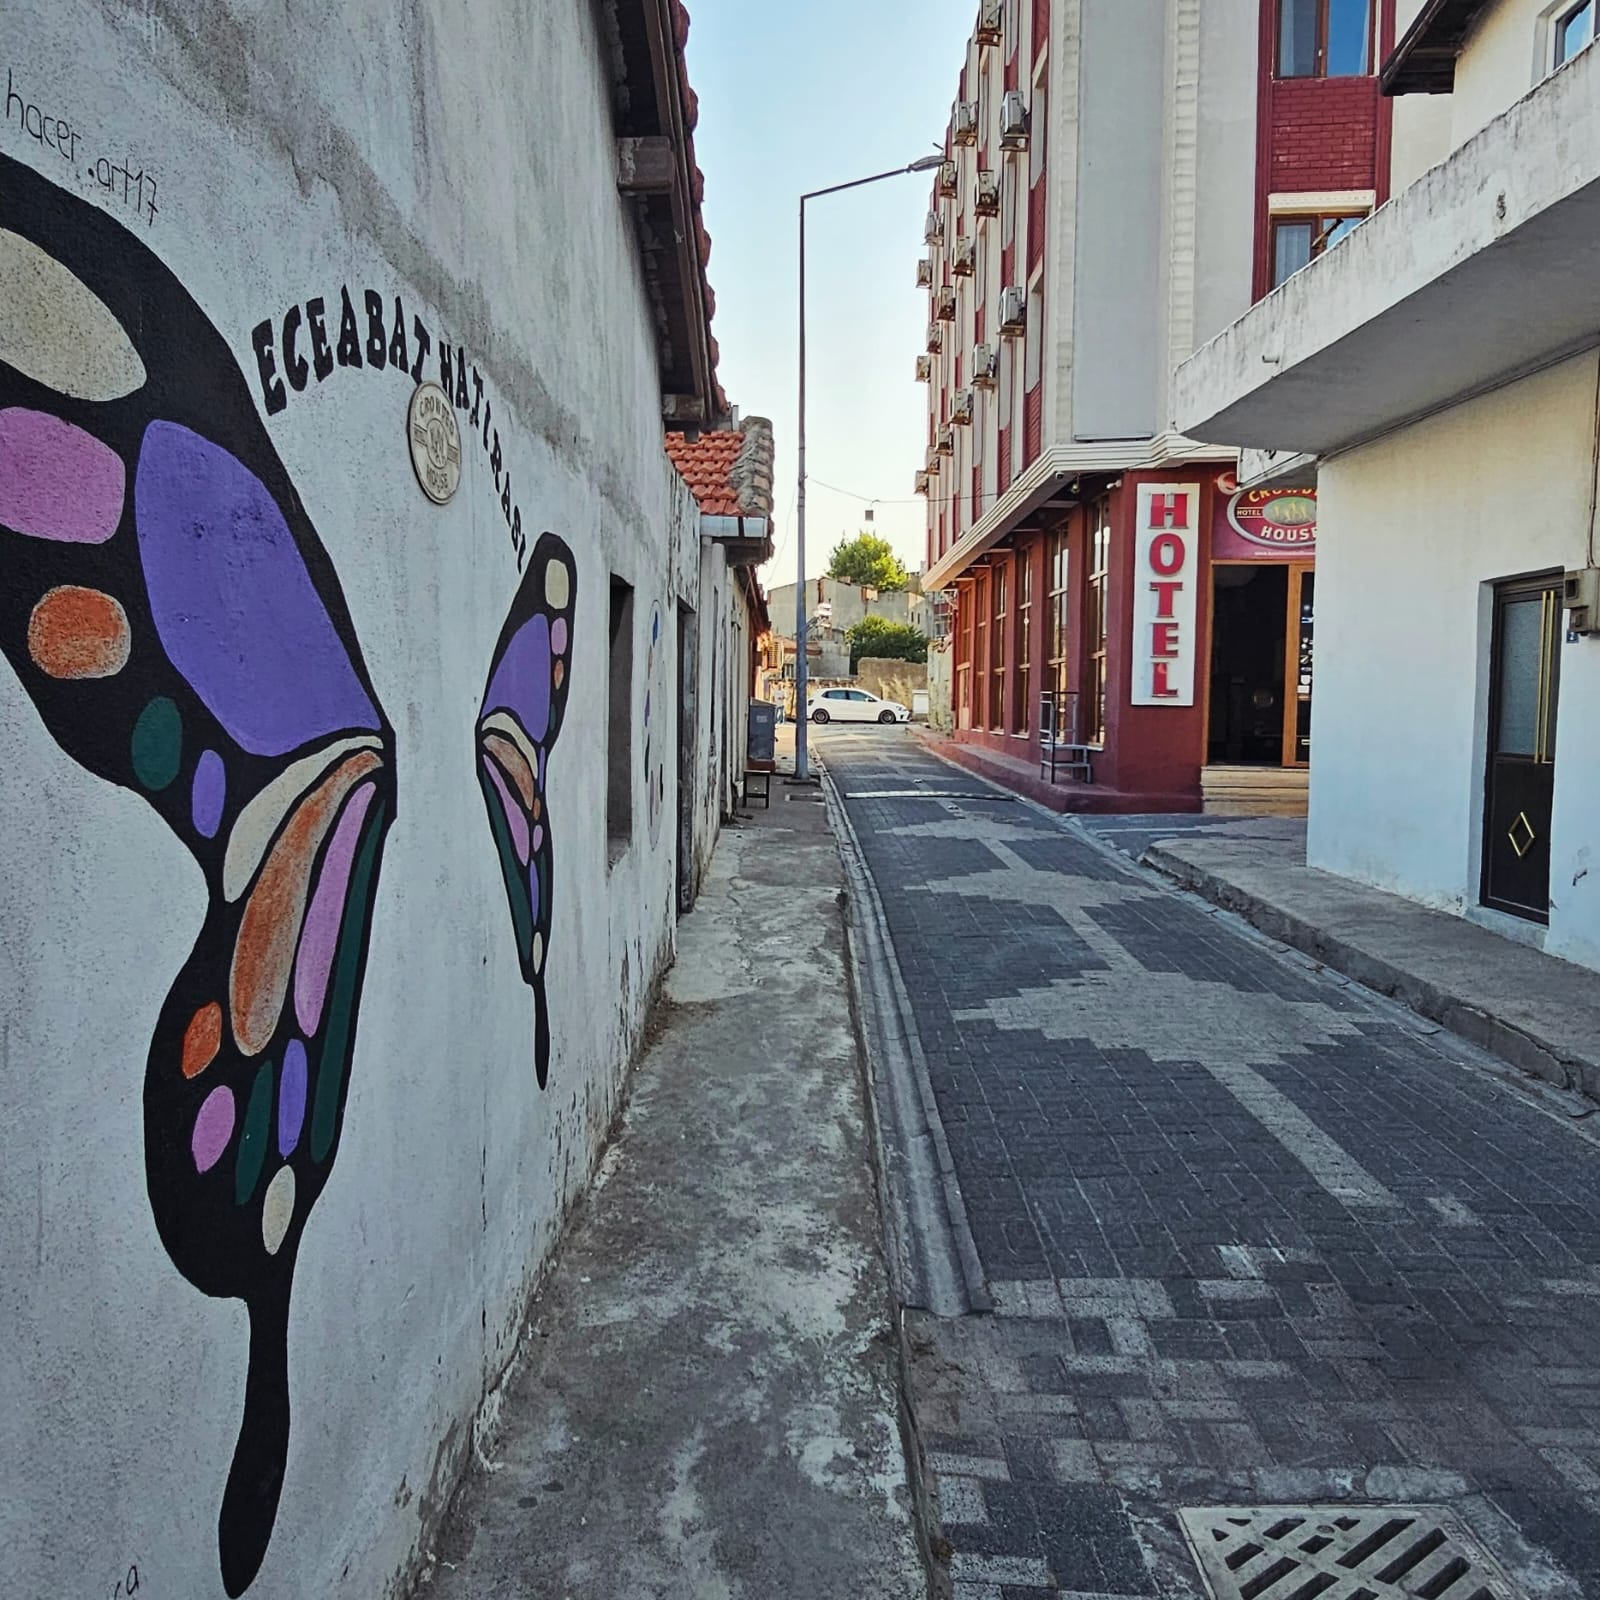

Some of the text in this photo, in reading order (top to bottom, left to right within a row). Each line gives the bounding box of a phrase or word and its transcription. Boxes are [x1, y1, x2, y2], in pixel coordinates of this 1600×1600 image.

[251, 284, 431, 416] ECEABAT
[1236, 508, 1262, 517] HOTEL
[1147, 493, 1190, 698] HOTEL
